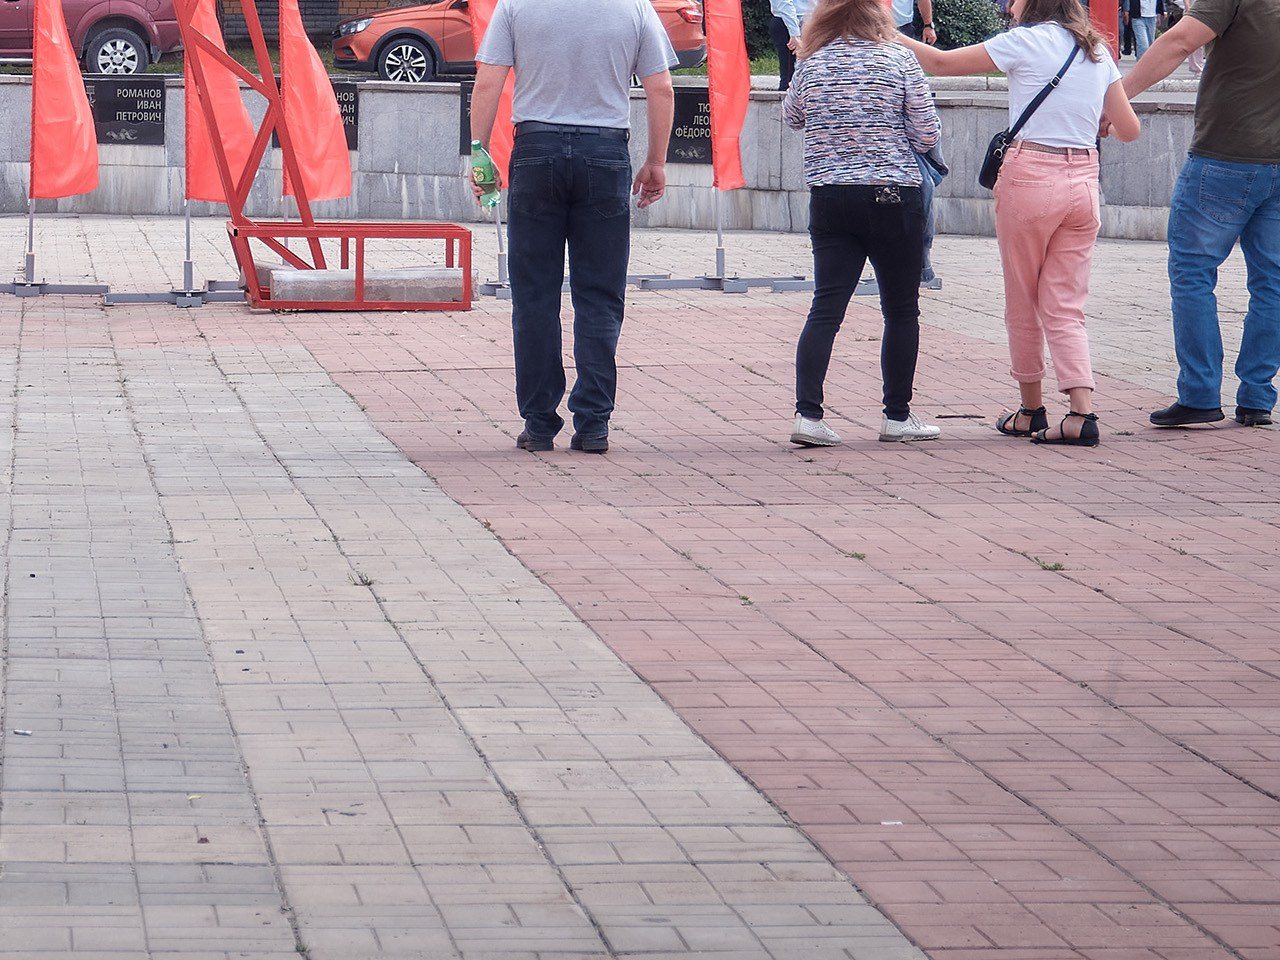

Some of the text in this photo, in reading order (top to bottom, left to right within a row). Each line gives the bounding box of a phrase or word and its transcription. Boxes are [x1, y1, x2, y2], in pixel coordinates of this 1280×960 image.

[116, 88, 162, 98] РОМАНОВ
[136, 100, 162, 110] ИВАН
[116, 111, 162, 121] ПЕТРОВИЧ
